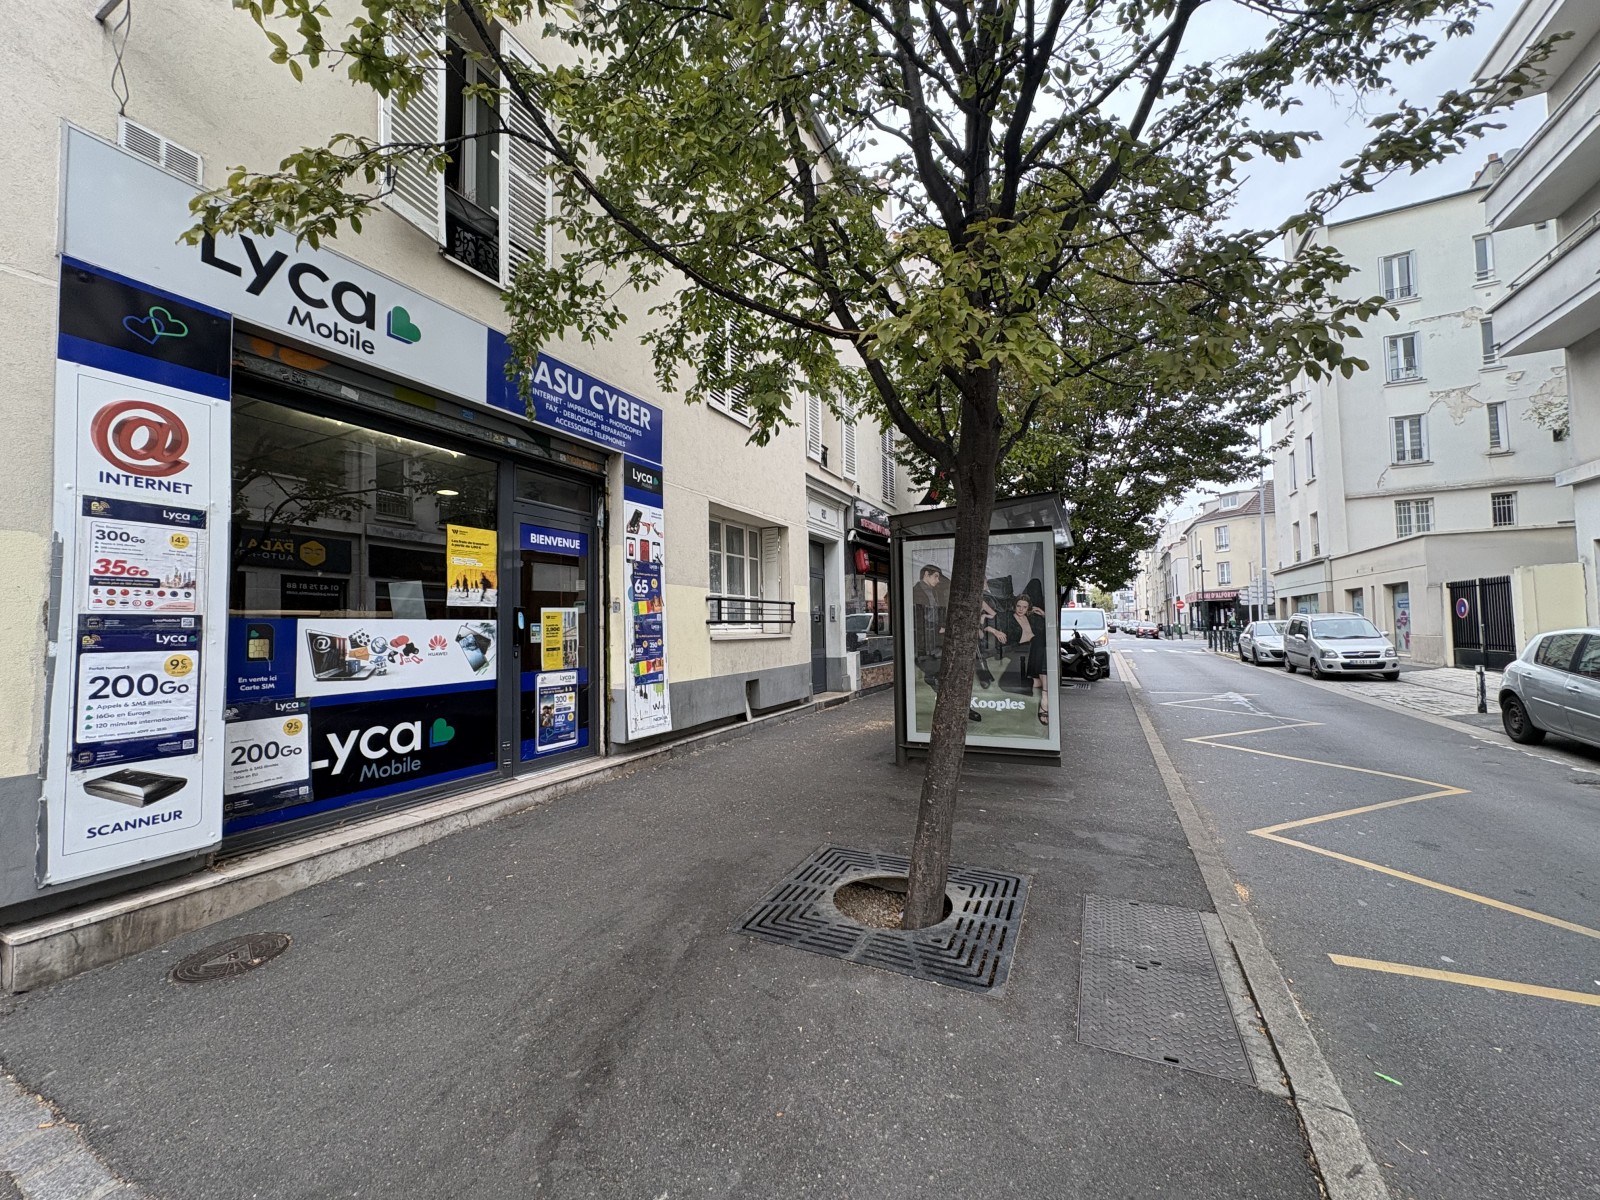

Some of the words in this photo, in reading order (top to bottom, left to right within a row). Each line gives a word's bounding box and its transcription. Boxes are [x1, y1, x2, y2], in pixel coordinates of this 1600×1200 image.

[201, 231, 376, 331] Lyca
[288, 305, 376, 355] Mobile
[532, 388, 562, 404] INTERNET
[567, 402, 604, 422] IMPRESSIONS
[609, 418, 642, 436] PHOTOCOPIES
[590, 386, 651, 430] CYBER
[546, 403, 558, 414] FAX
[563, 410, 597, 428] DEBLOCAGE
[601, 424, 632, 441] REPARATION
[555, 417, 593, 436] ACCESSOIRES
[594, 430, 626, 448] TELEPHONES
[99, 470, 192, 494] INTERNET
[632, 468, 652, 484] Lyca
[163, 510, 190, 520] Lyca
[95, 529, 146, 544] 300Go
[530, 533, 580, 550] BIENVENUE
[93, 558, 149, 576] 35Go
[634, 579, 649, 594] 65
[156, 634, 187, 643] Lyca
[89, 674, 189, 700] 200Go
[275, 702, 299, 711] Lyca
[970, 697, 1025, 711] Kooples
[231, 741, 302, 766] 200Go
[359, 756, 421, 782] Mobile
[86, 810, 183, 838] SCANNEUR
